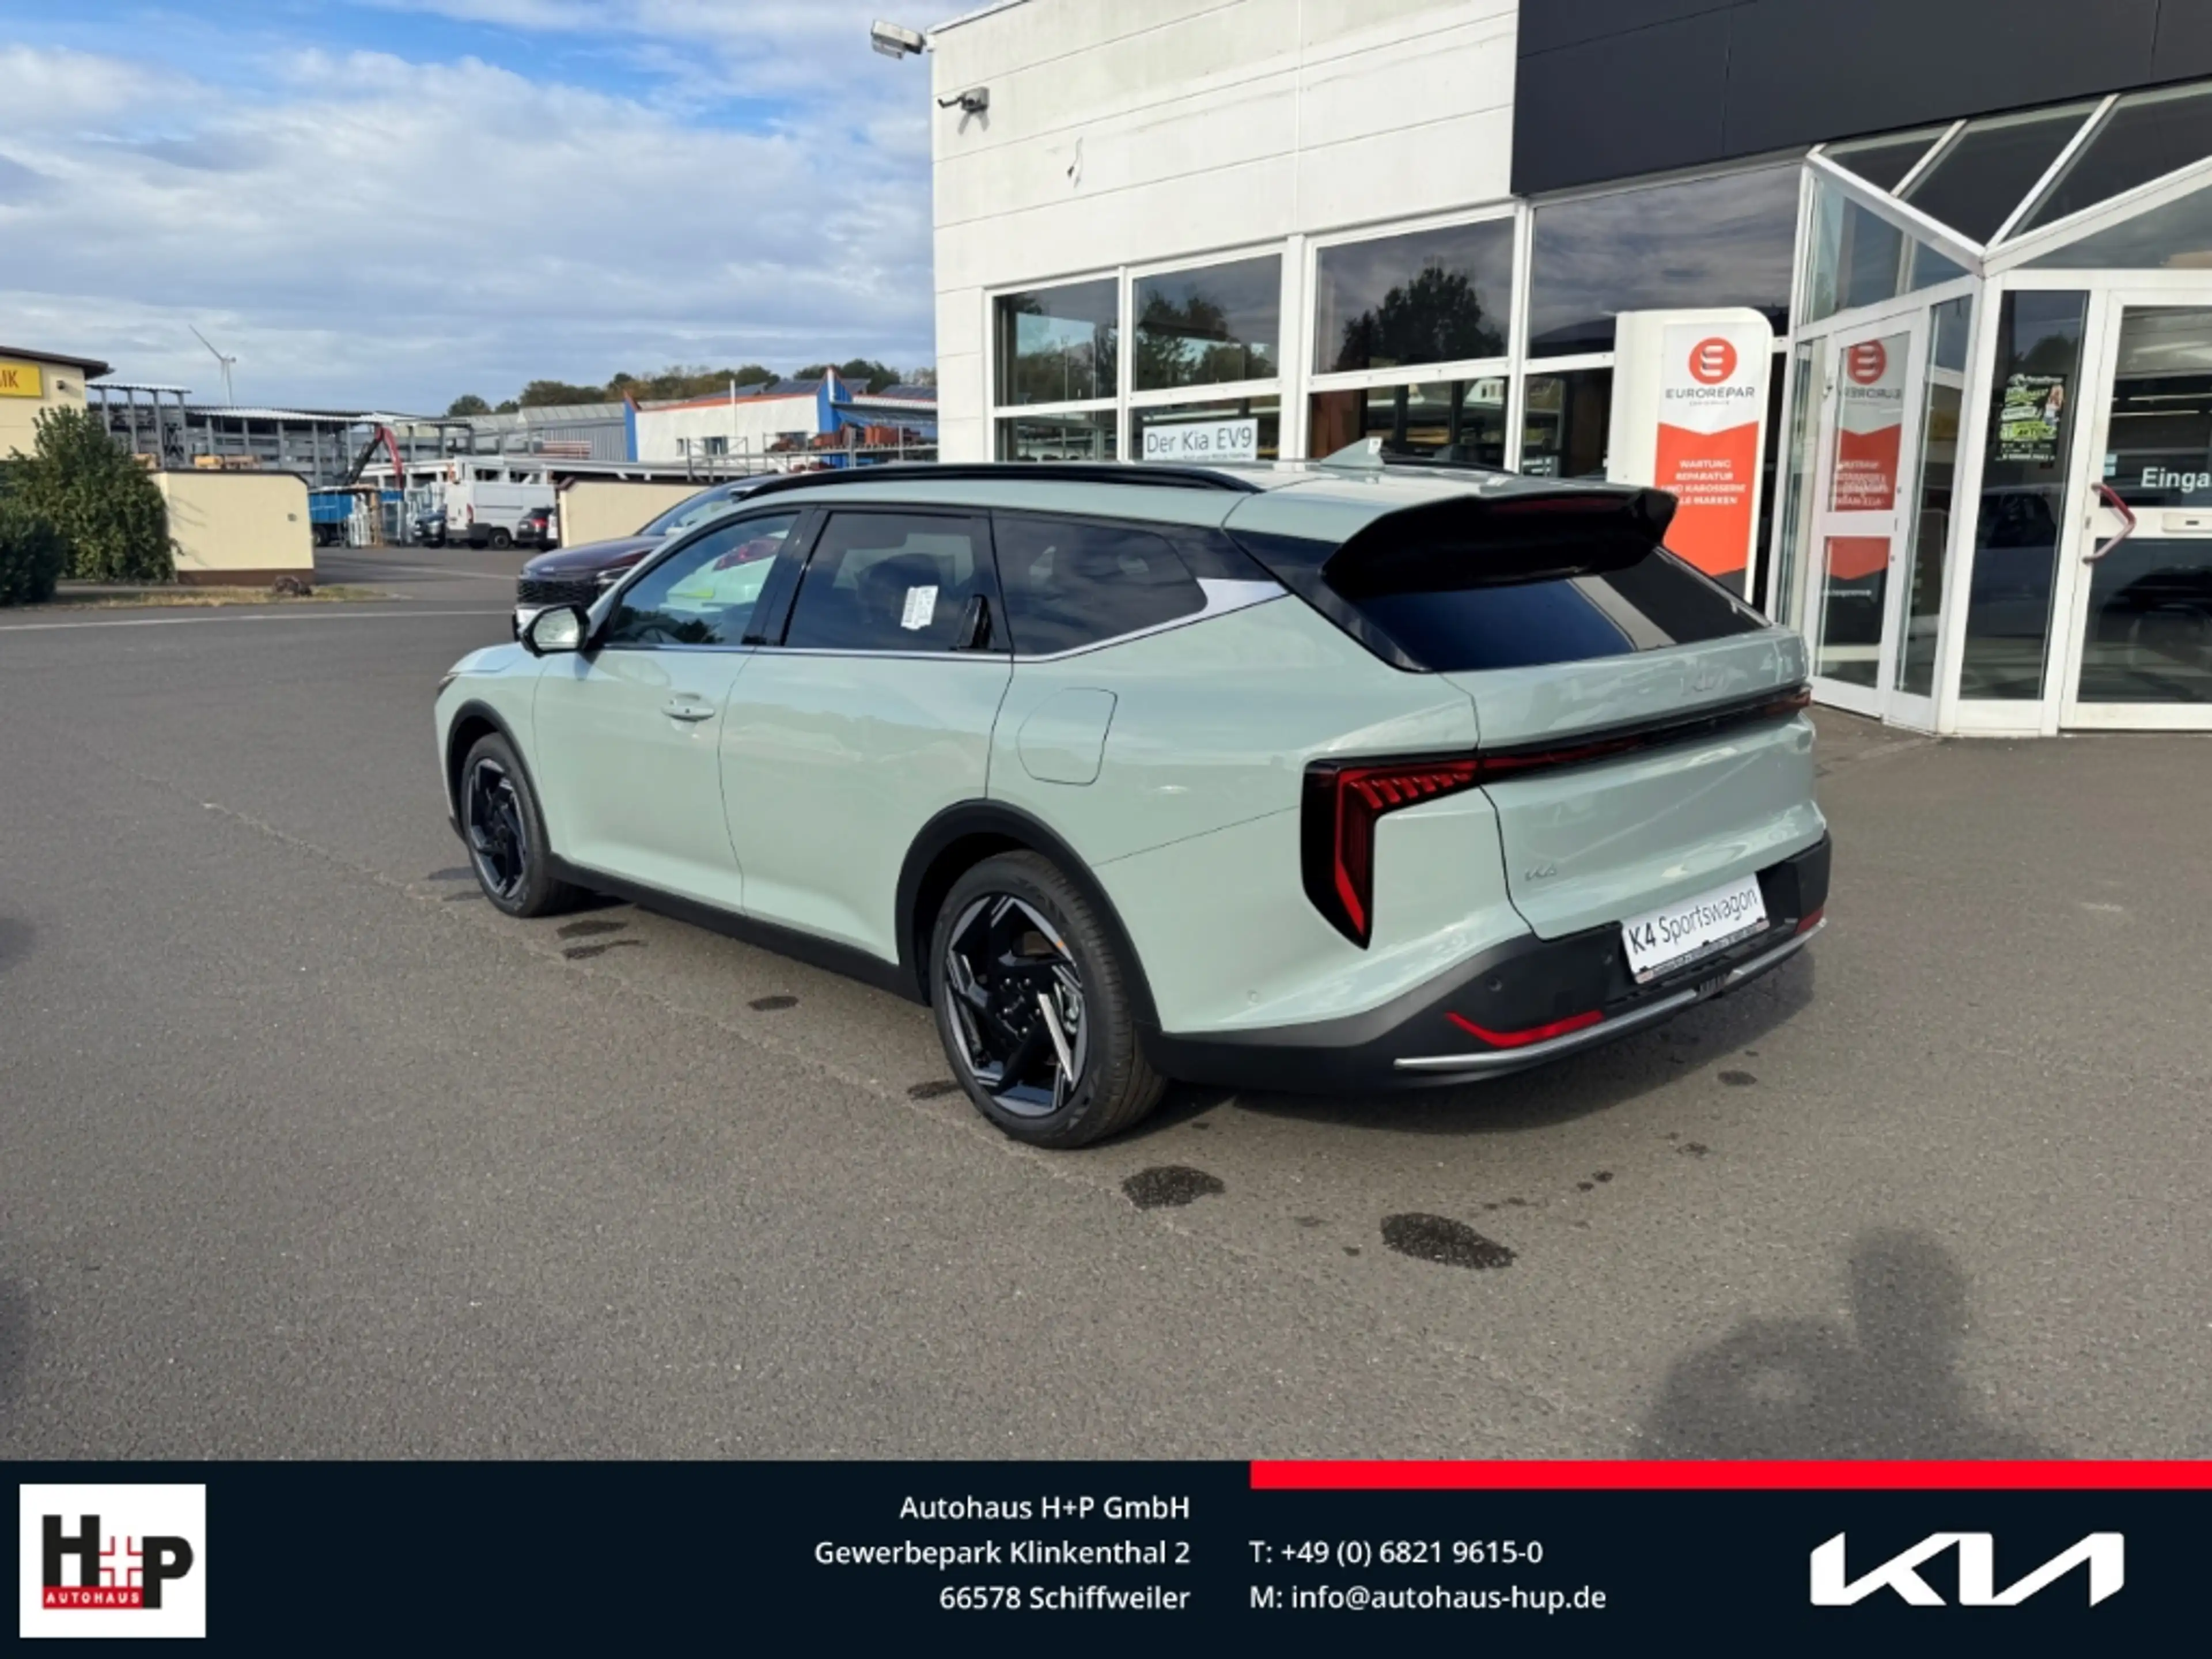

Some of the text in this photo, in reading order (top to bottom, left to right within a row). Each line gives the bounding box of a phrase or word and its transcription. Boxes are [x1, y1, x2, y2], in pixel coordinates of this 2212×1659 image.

[1665, 387, 1755, 399] EUROREPAR
[1146, 427, 1252, 453] Der Kia EV9
[1679, 459, 1731, 468] WARTUNG
[1675, 471, 1733, 481] REPARATUR
[2141, 467, 2210, 493] Einga
[1693, 496, 1738, 505] MARKEN
[1628, 887, 1758, 954] K4 Sportswagon
